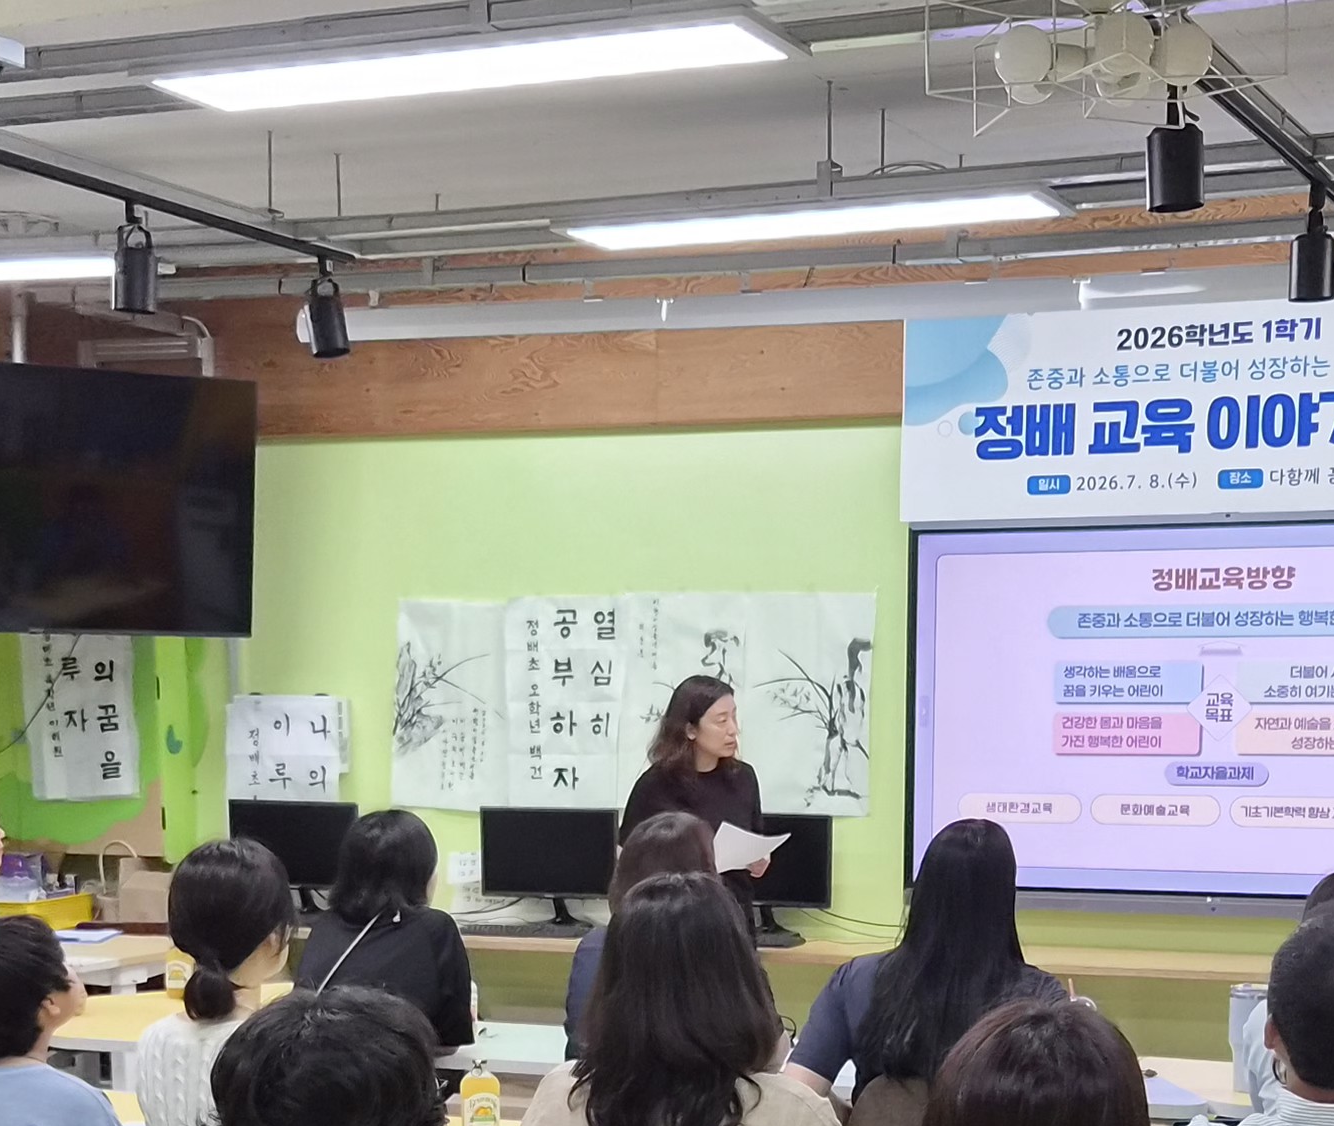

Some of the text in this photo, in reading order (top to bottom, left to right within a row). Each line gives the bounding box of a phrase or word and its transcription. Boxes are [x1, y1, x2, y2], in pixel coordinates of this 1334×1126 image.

[1116, 316, 1322, 351] 2026학년도 1학기
[1026, 366, 1085, 391] 존중과
[1092, 364, 1171, 388] 소통으로
[1179, 359, 1240, 384] 더불어
[1248, 354, 1331, 381] 성장하는
[973, 403, 1076, 461] 정배
[1088, 398, 1195, 455] 교육
[1038, 472, 1198, 491] 일시 2026.7. 8.(수)
[1229, 471, 1252, 485] 장소
[1269, 466, 1320, 486] 다함께
[1152, 565, 1296, 591] 정배교육방향
[1077, 612, 1121, 628] 존중과
[1124, 611, 1182, 628] 소통으로
[1186, 611, 1230, 627] 더불어
[1234, 610, 1294, 627] 성장하는
[1063, 665, 1161, 679] 생각하는 배움으로
[1290, 665, 1327, 679] 더불어
[1063, 684, 1163, 698] 꿈을 키우는 어린이
[1263, 685, 1302, 699] 소중히
[1205, 692, 1234, 707] 교육
[1205, 708, 1233, 723] 목표
[1062, 716, 1163, 730] 건강한 몸과 마음을
[1254, 717, 1292, 731] 자연과
[1294, 717, 1331, 731] 예술을
[1061, 735, 1162, 749] 가진 행복한 어린이
[1176, 766, 1254, 780] 학교자율과제
[986, 801, 1053, 815] 생태환경교육
[1120, 803, 1190, 817] 문화예술교육
